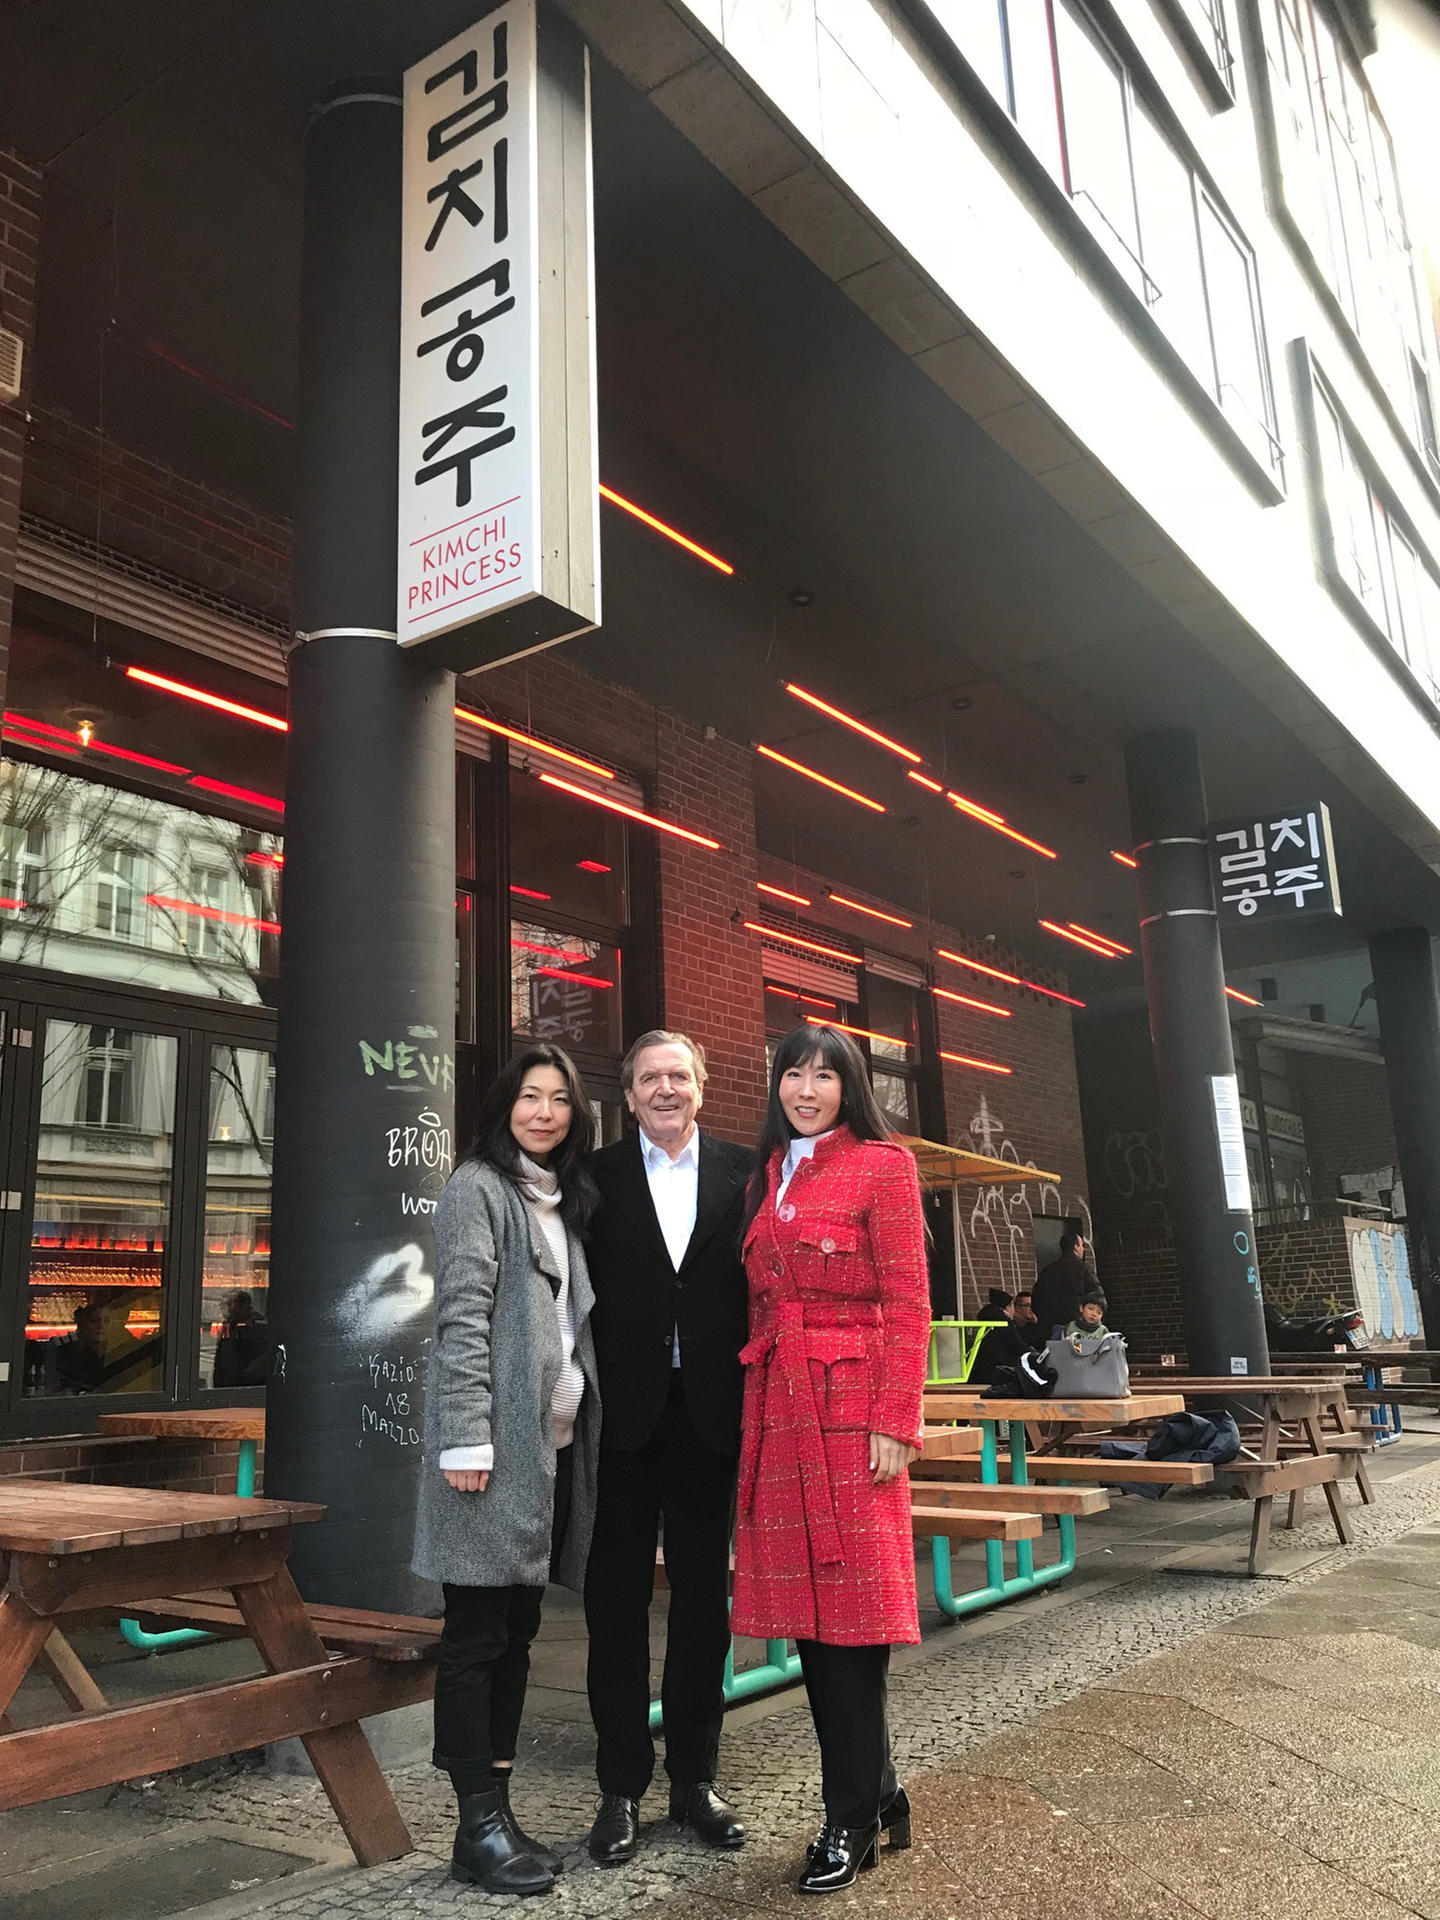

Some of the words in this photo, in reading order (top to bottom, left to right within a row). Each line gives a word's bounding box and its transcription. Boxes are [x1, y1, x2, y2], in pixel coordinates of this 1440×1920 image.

[423, 516, 506, 573] KIMCHI
[408, 542, 522, 610] PRINCESS
[1216, 812, 1321, 874] 김치
[1222, 864, 1324, 916] 공주
[385, 1392, 410, 1416] 18
